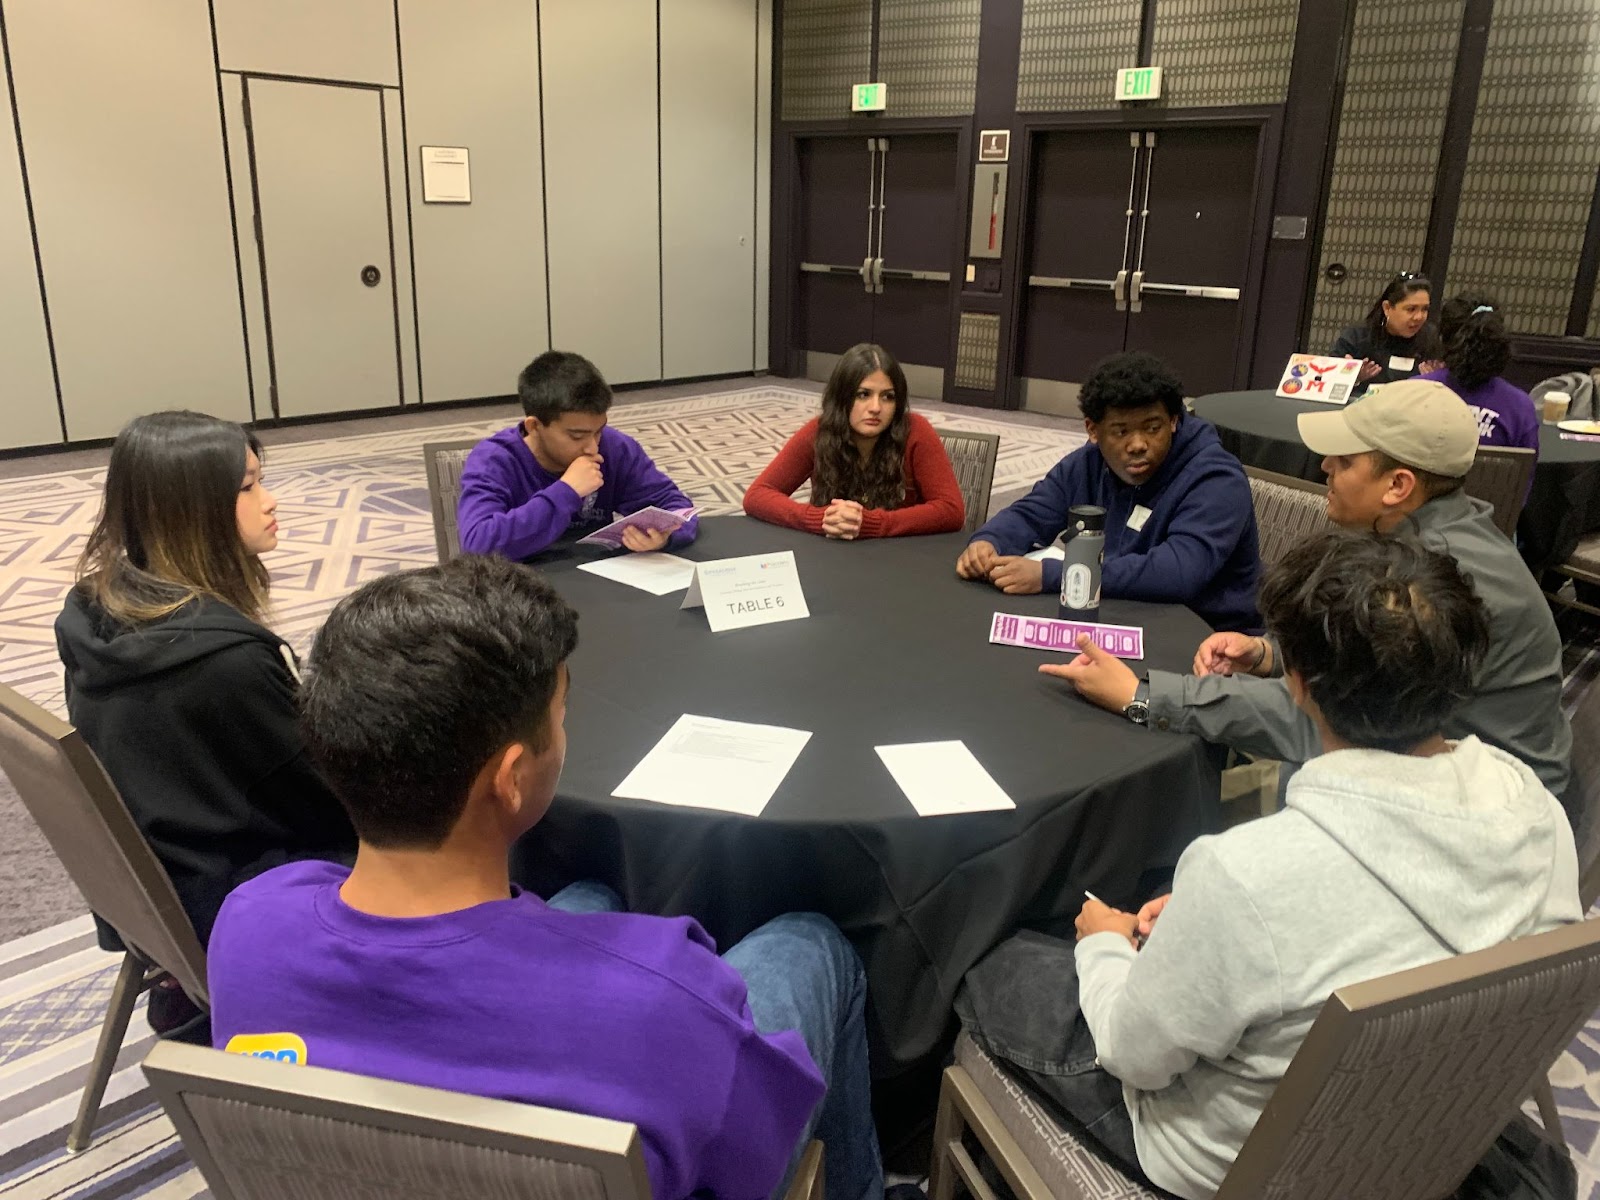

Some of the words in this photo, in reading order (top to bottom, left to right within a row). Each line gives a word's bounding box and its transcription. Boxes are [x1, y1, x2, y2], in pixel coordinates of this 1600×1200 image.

[1124, 70, 1153, 95] EXIT
[858, 85, 878, 108] EXIT
[726, 597, 774, 615] TABLE
[776, 596, 785, 607] 6
